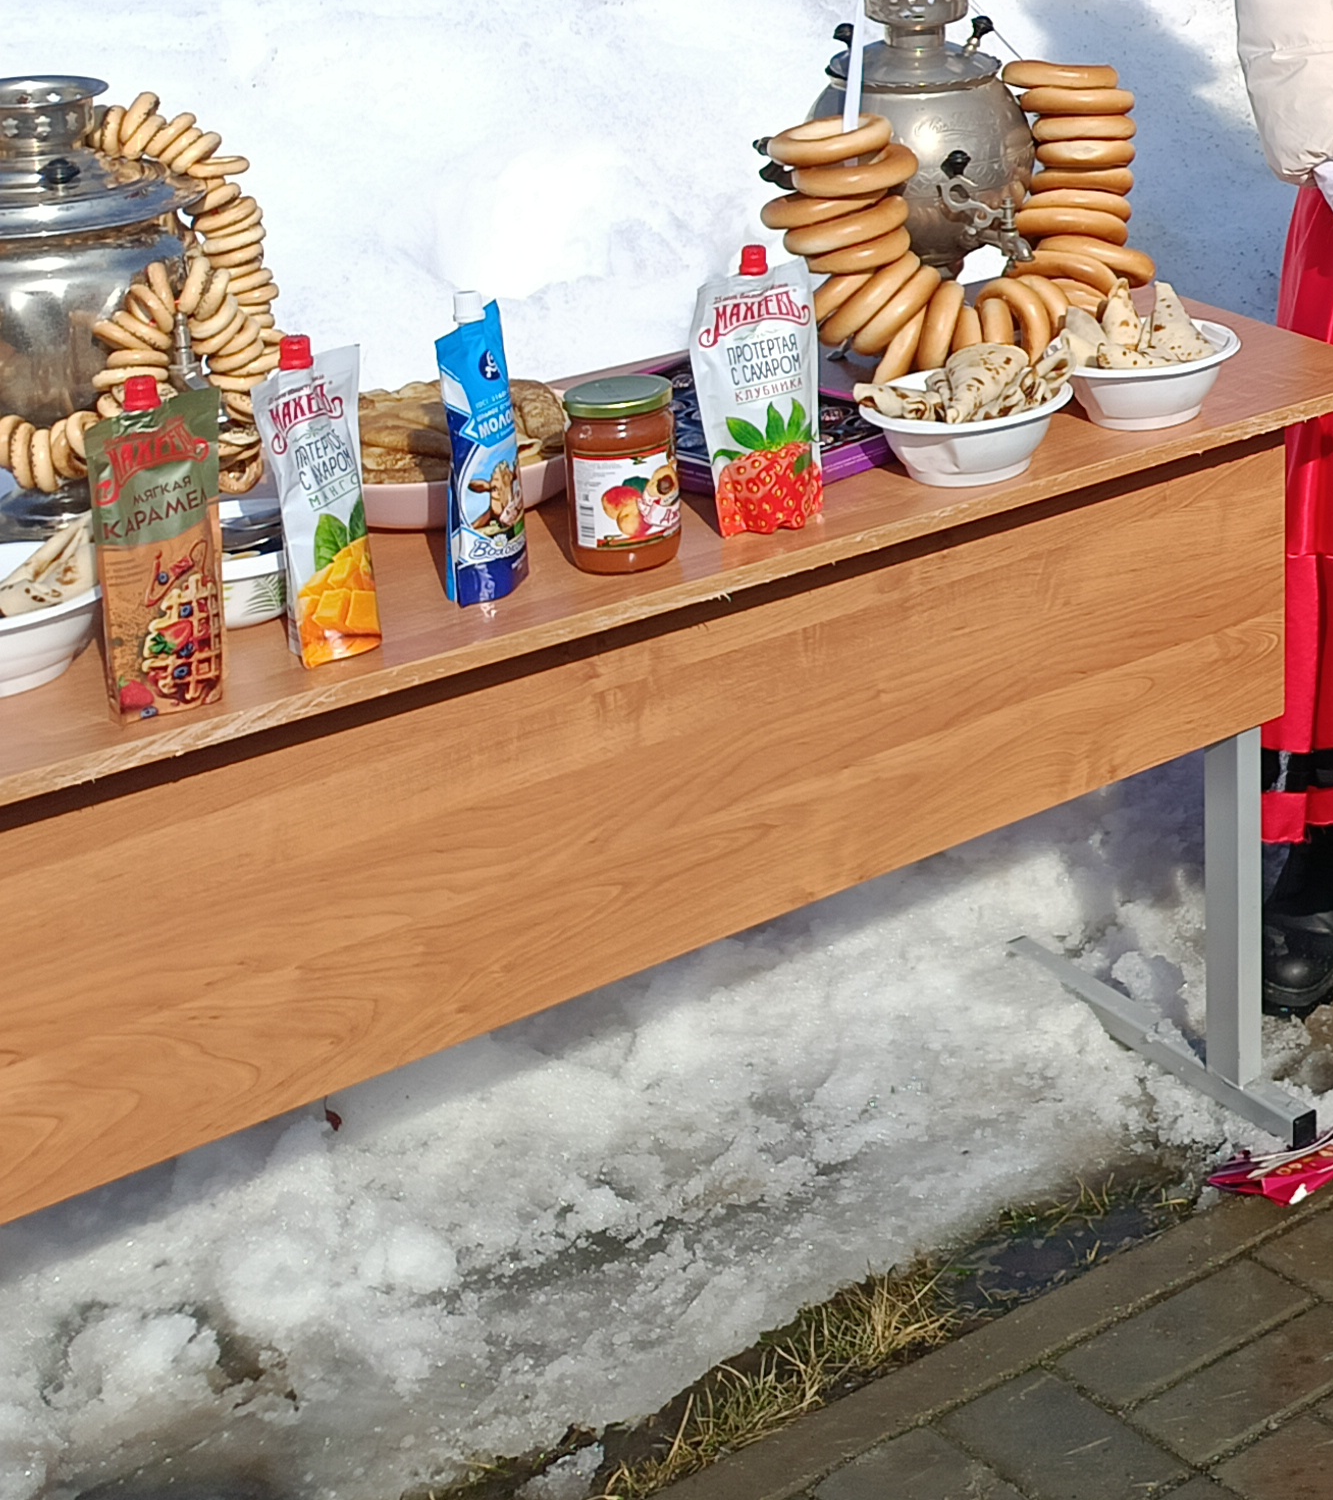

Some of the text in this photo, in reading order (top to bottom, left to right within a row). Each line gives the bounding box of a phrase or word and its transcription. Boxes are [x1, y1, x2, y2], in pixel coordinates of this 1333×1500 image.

[727, 333, 798, 366] ПРОТЕРТАЯ
[731, 353, 801, 386] С САХАРОМ
[735, 377, 803, 402] КЛУБНИКА
[133, 475, 192, 506] МЯГКАЯ
[300, 472, 312, 491] С
[309, 472, 360, 508] МАНГО
